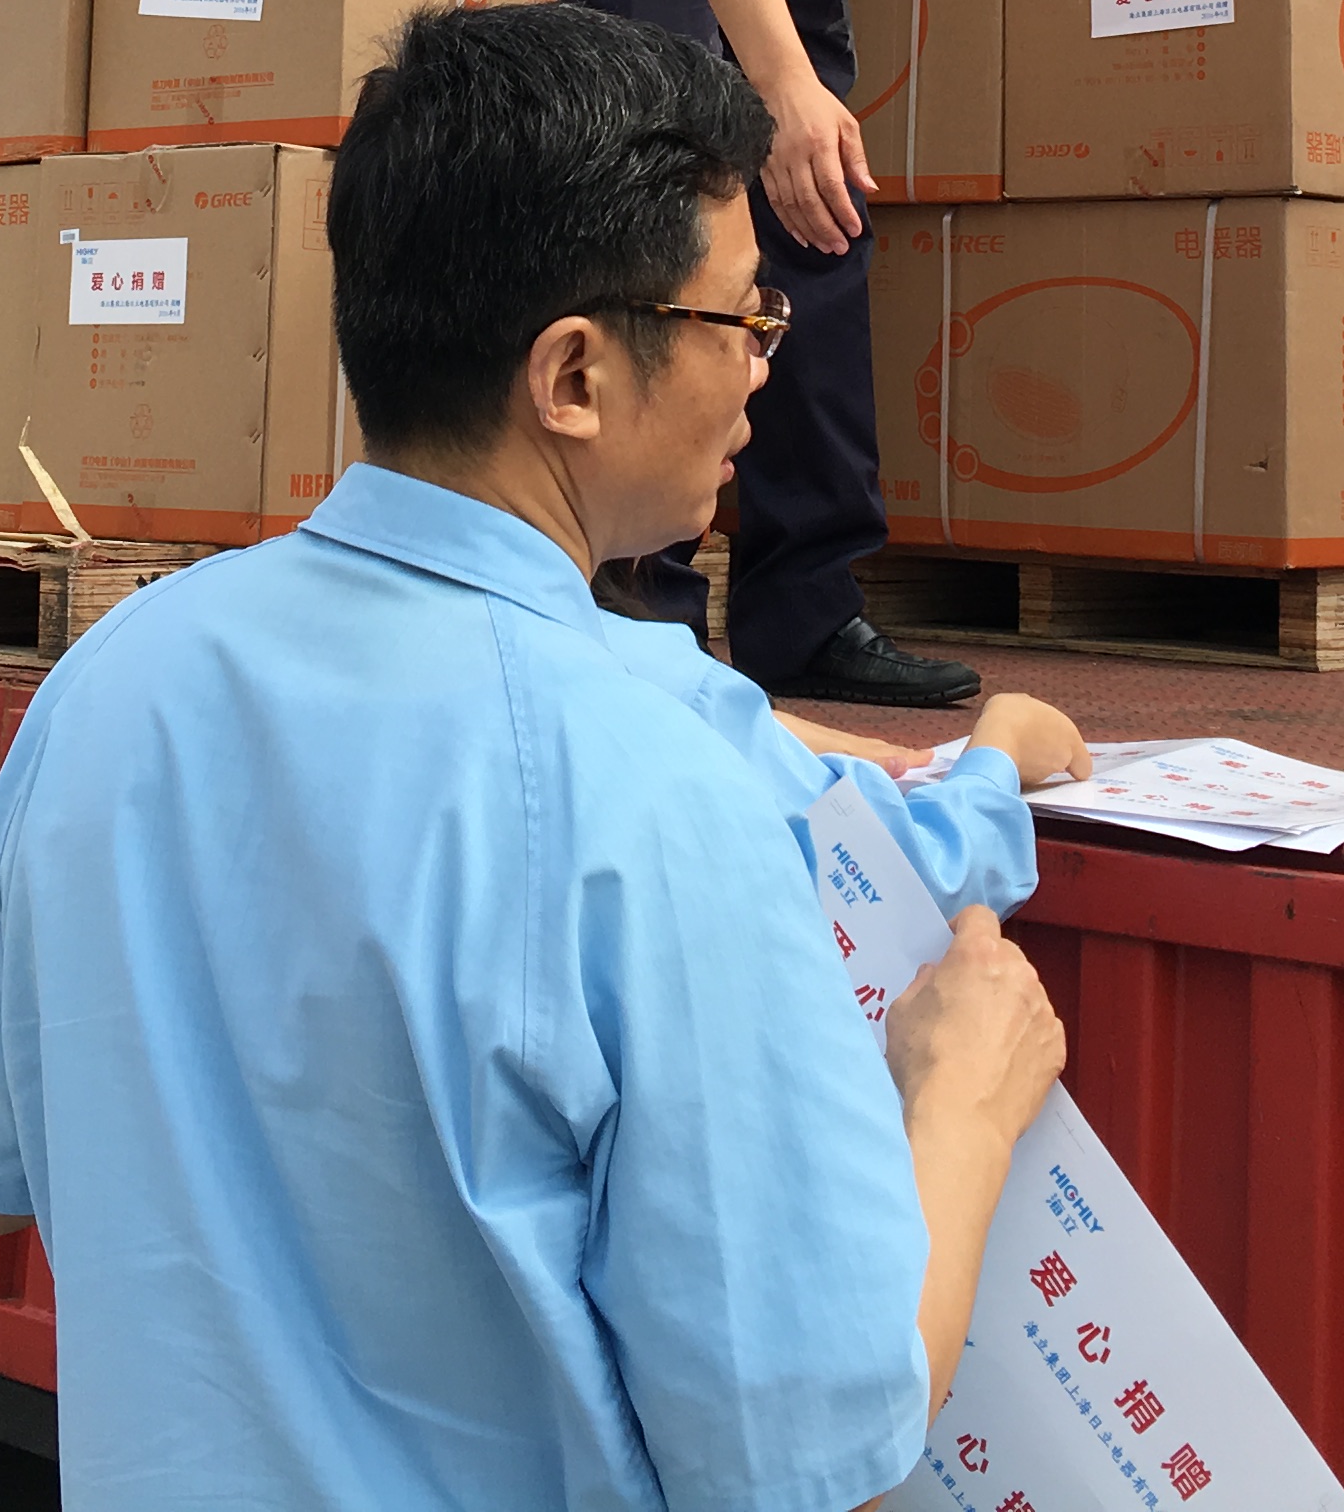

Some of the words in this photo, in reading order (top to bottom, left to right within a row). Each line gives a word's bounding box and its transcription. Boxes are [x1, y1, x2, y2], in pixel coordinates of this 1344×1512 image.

[1025, 145, 1072, 159] GREE
[210, 191, 254, 210] GREE
[90, 271, 166, 292] 爱心捐赠
[827, 868, 859, 909] 海立
[830, 842, 882, 906] HIGHLY
[1045, 1193, 1079, 1237] 海立
[1049, 1164, 1104, 1234] HIGHLY
[1029, 1250, 1212, 1502] 爱心捐赠
